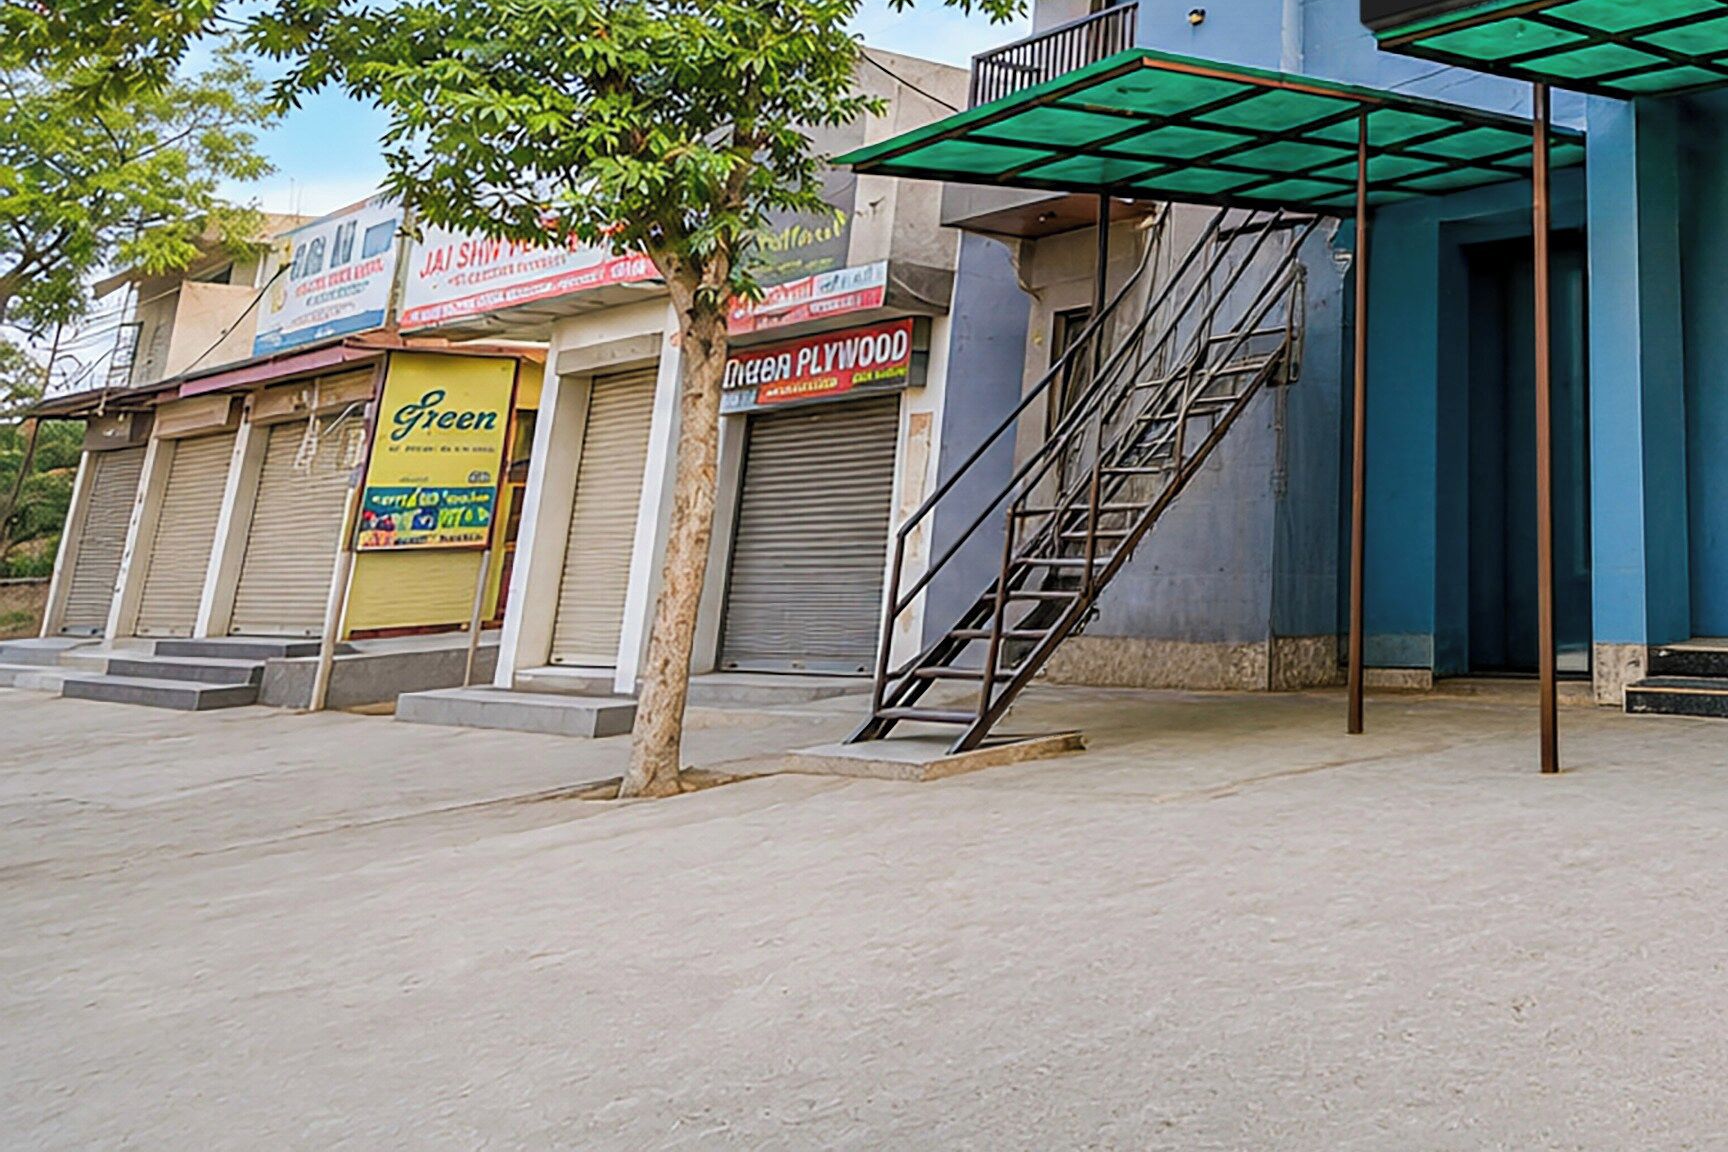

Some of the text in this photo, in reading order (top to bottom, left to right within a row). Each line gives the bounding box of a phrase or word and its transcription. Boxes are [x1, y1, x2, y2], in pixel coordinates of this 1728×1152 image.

[420, 243, 453, 279] JAI
[796, 329, 908, 378] PLYWOOD
[390, 389, 498, 442] Green
